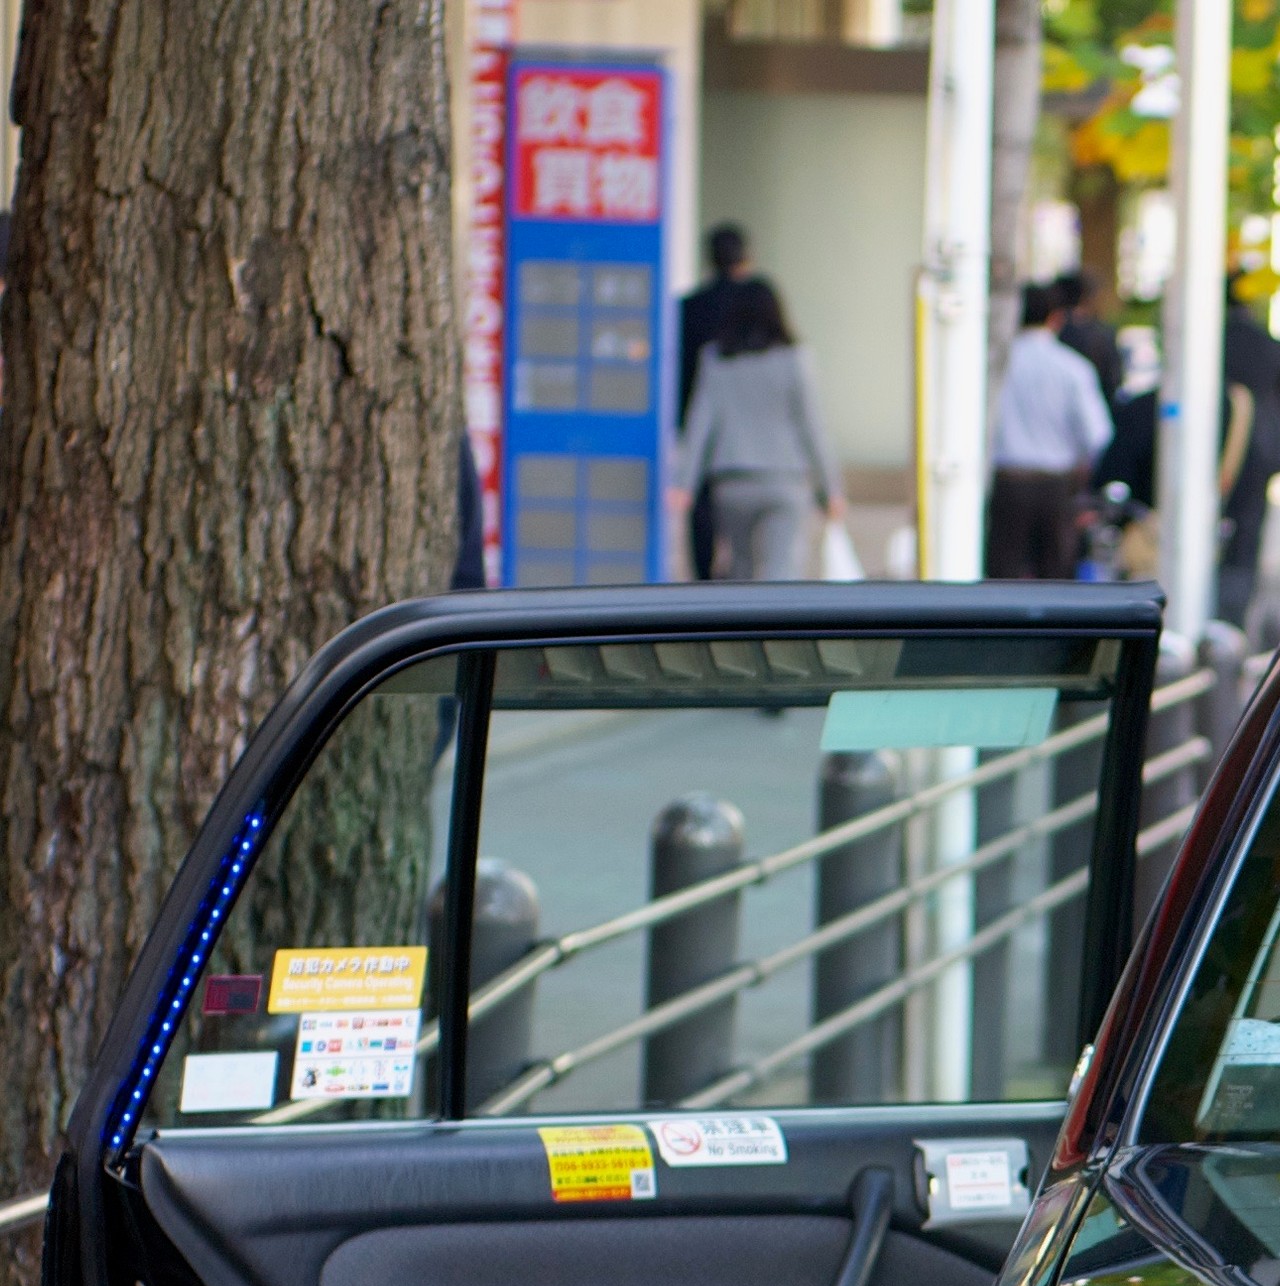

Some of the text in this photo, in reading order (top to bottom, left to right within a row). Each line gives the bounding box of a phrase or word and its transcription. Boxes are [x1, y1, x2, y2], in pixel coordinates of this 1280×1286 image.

[518, 78, 645, 143] 飲食
[533, 149, 659, 213] 買物
[708, 1141, 779, 1157] No Smoking
